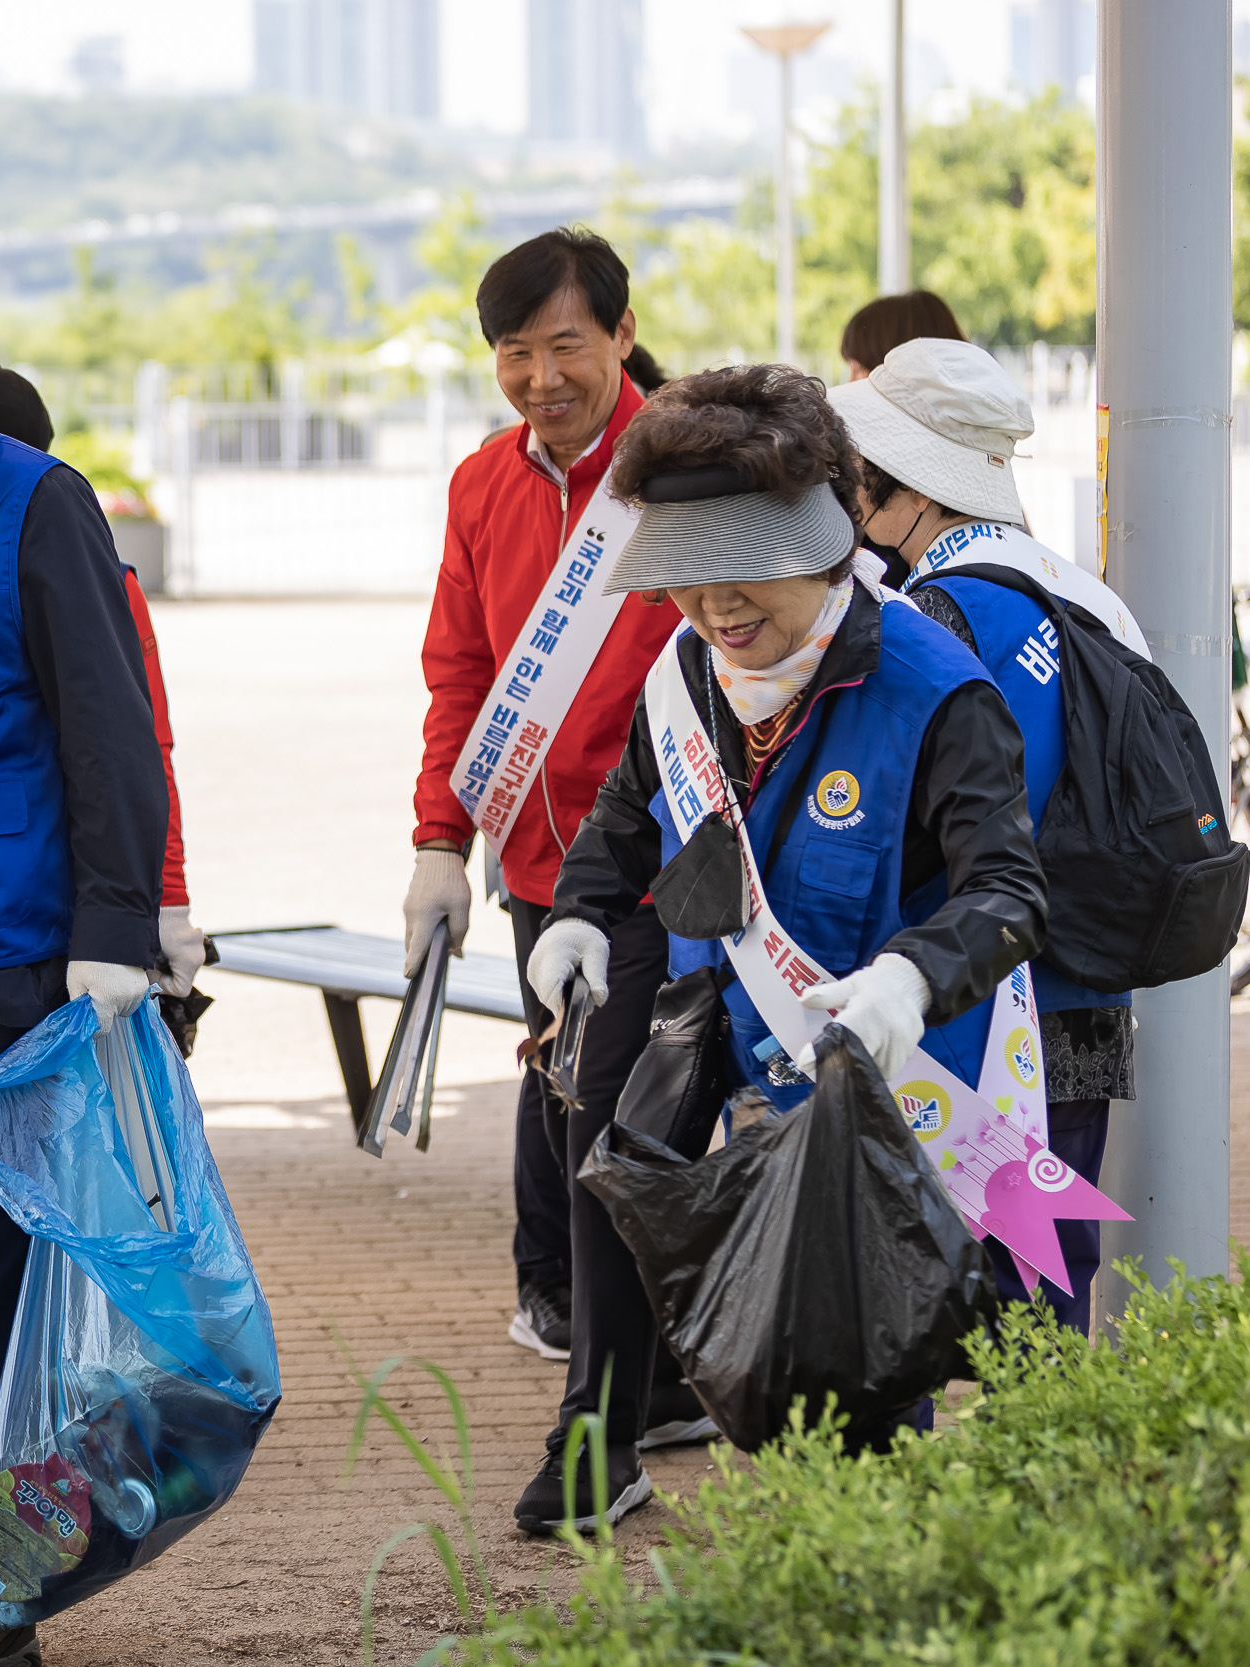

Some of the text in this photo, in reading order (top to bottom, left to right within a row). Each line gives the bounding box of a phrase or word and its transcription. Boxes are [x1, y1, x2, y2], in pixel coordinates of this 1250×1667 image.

[554, 526, 607, 608] “국민과
[529, 608, 570, 656] 함께
[505, 655, 544, 704] 하는
[480, 719, 550, 840] 광진구협의회
